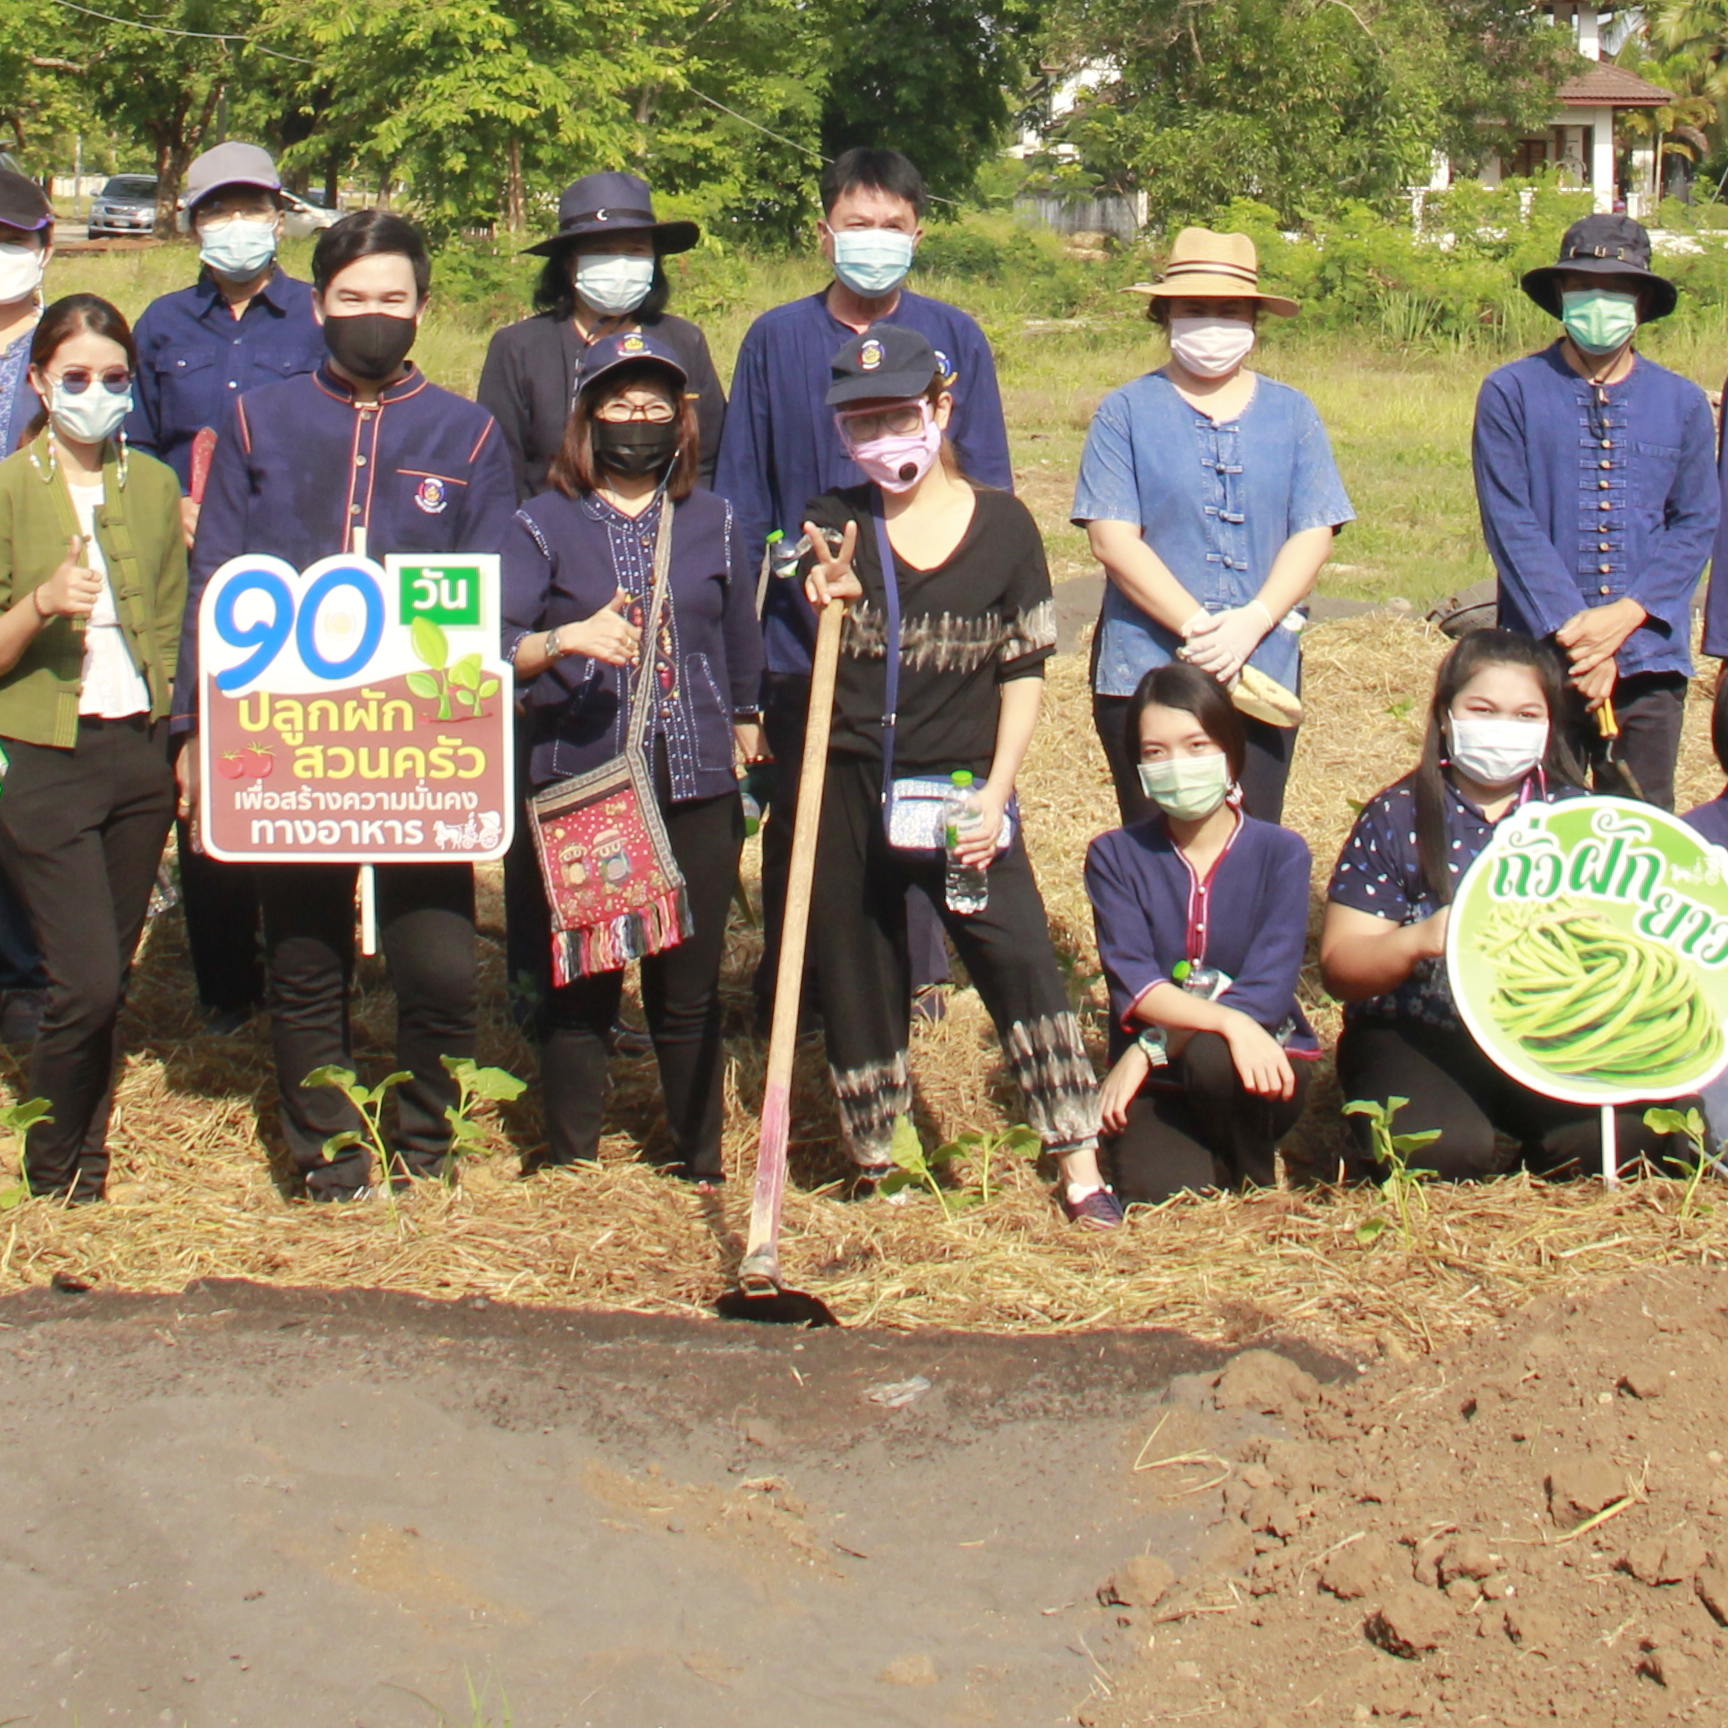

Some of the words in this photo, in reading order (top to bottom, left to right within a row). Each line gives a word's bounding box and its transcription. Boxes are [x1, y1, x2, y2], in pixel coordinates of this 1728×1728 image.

[412, 568, 469, 610] วัน
[214, 566, 386, 691] 90
[238, 688, 415, 746] ปลูกผัก
[292, 735, 486, 779] สวนครัว
[234, 779, 479, 811] เพื่อสร้างความมั่นคง
[251, 819, 424, 845] ทางอาหาร
